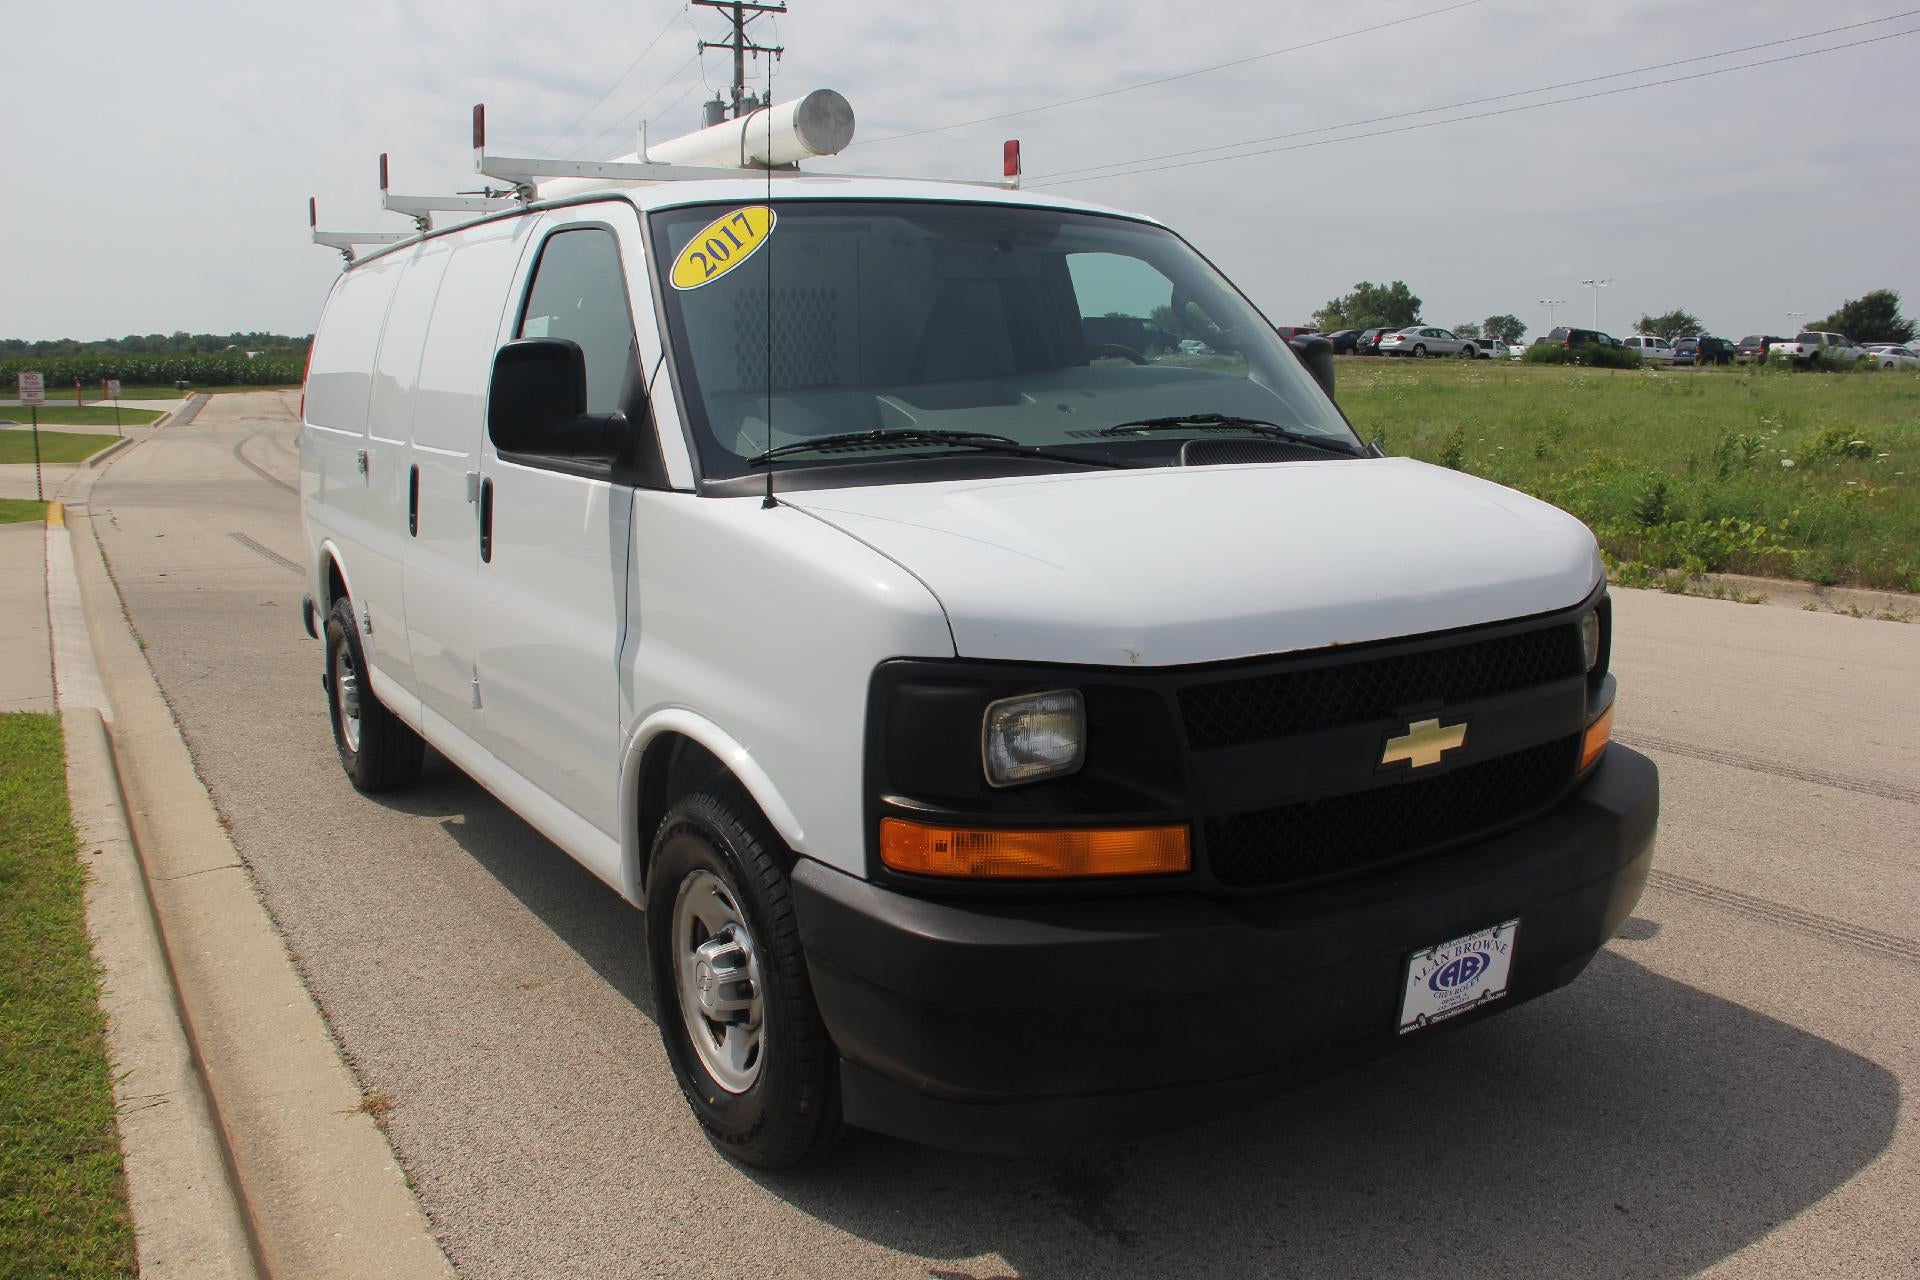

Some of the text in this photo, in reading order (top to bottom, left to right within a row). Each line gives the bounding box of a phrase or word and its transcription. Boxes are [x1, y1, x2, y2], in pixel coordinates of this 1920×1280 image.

[690, 212, 754, 278] 2017
[1413, 939, 1509, 987] ALAN BROWNE
[1439, 956, 1481, 987] AB
[1433, 976, 1481, 999] CHEVROLET
